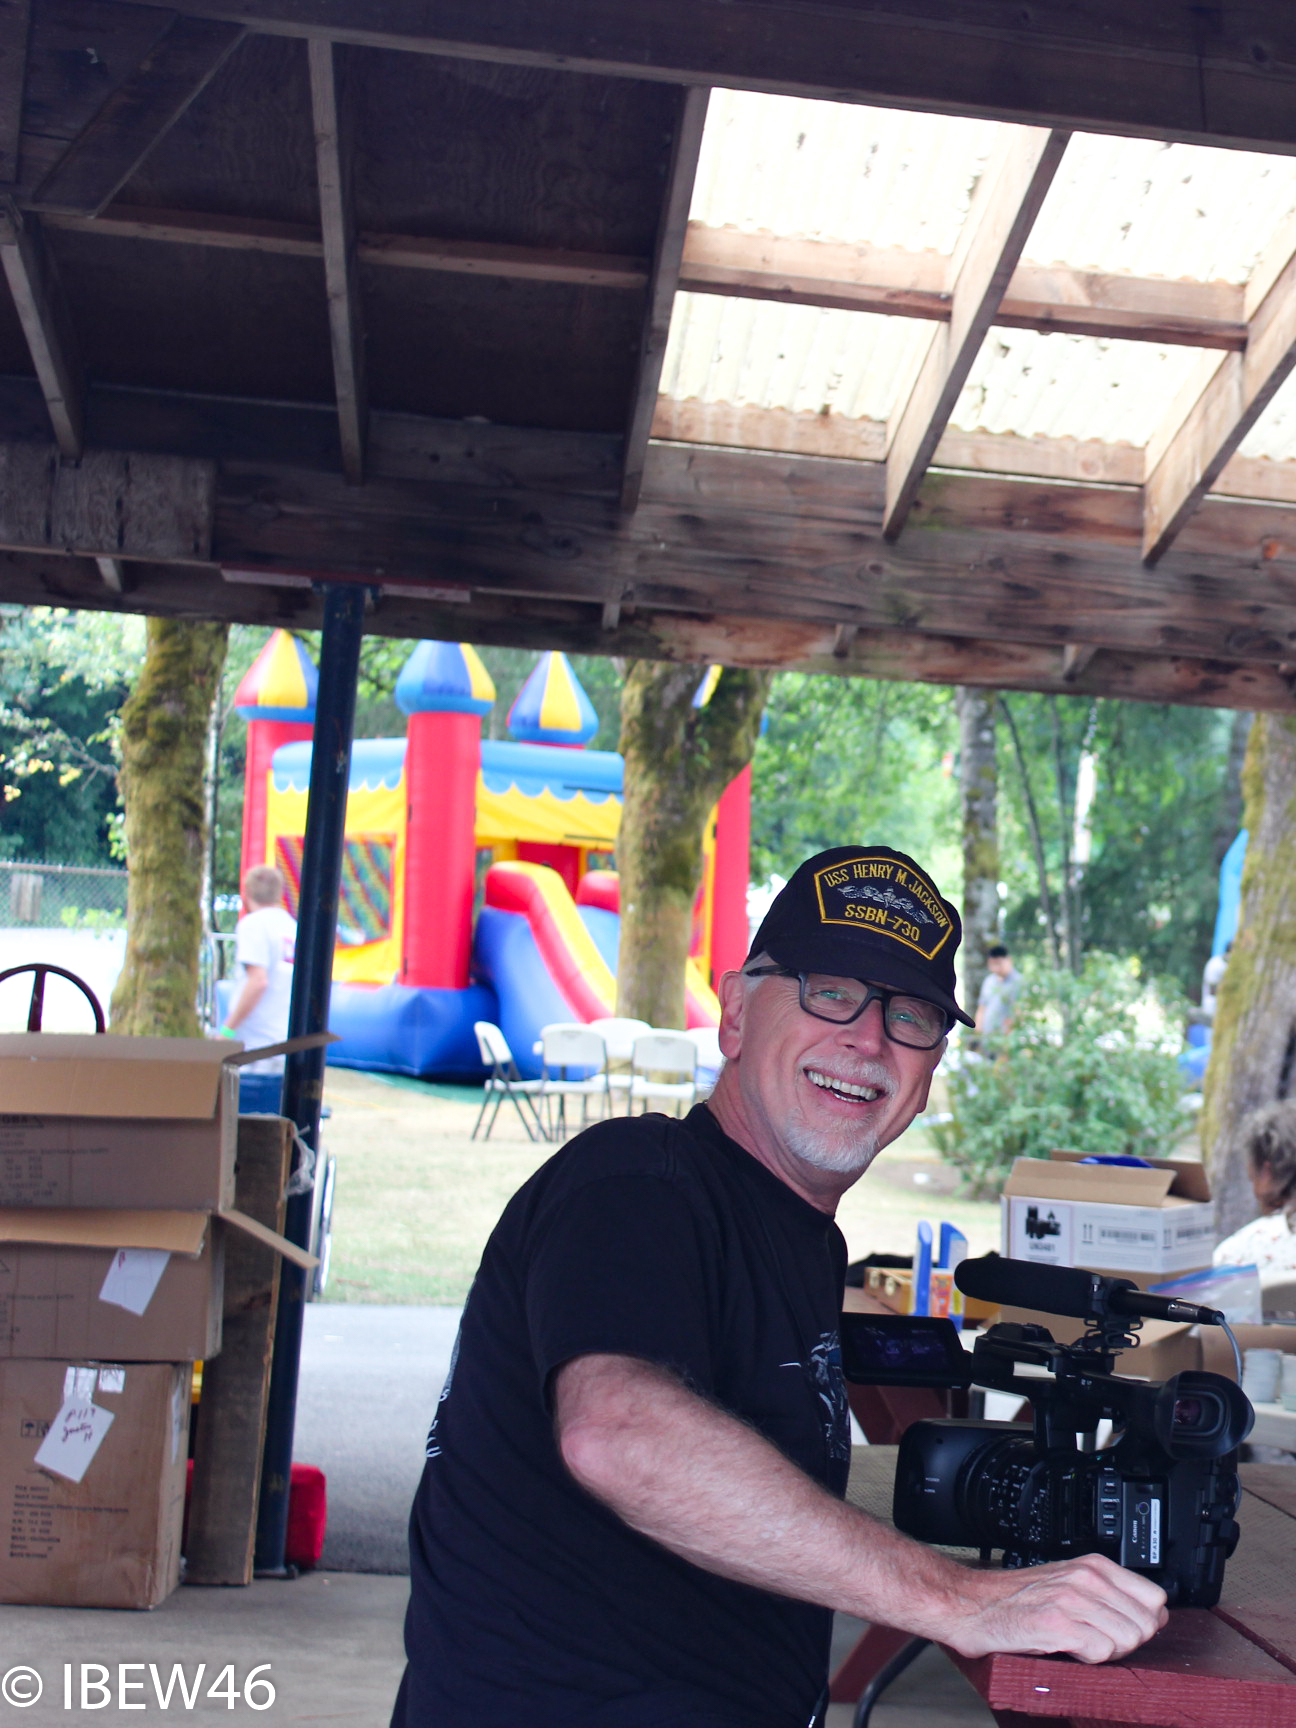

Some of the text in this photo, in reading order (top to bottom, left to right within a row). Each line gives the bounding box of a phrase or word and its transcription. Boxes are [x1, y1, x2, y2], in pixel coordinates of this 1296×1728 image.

[824, 864, 948, 928] USS HENRY M. JACKSON
[845, 904, 920, 941] SSBN-730
